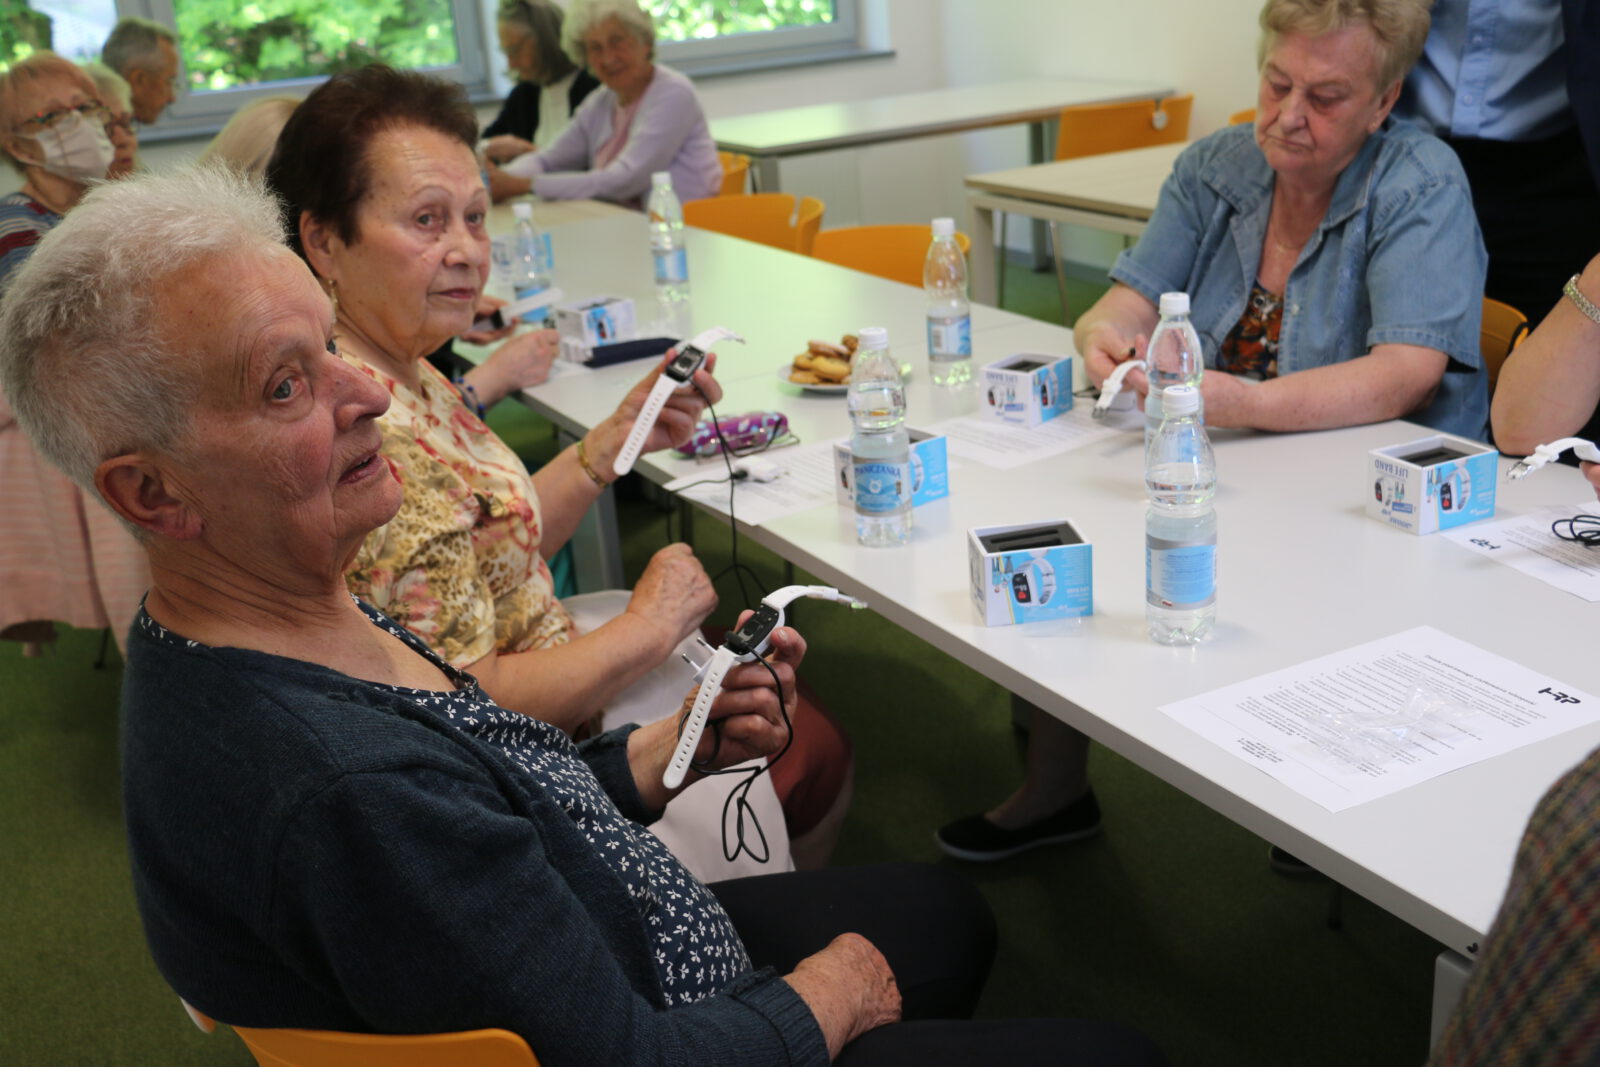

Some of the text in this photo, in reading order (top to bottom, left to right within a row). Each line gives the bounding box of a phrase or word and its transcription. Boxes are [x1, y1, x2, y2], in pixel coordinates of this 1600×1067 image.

[1374, 459, 1393, 475] BAND
[1395, 464, 1409, 479] LIFE
[1538, 687, 1581, 704] HRP
